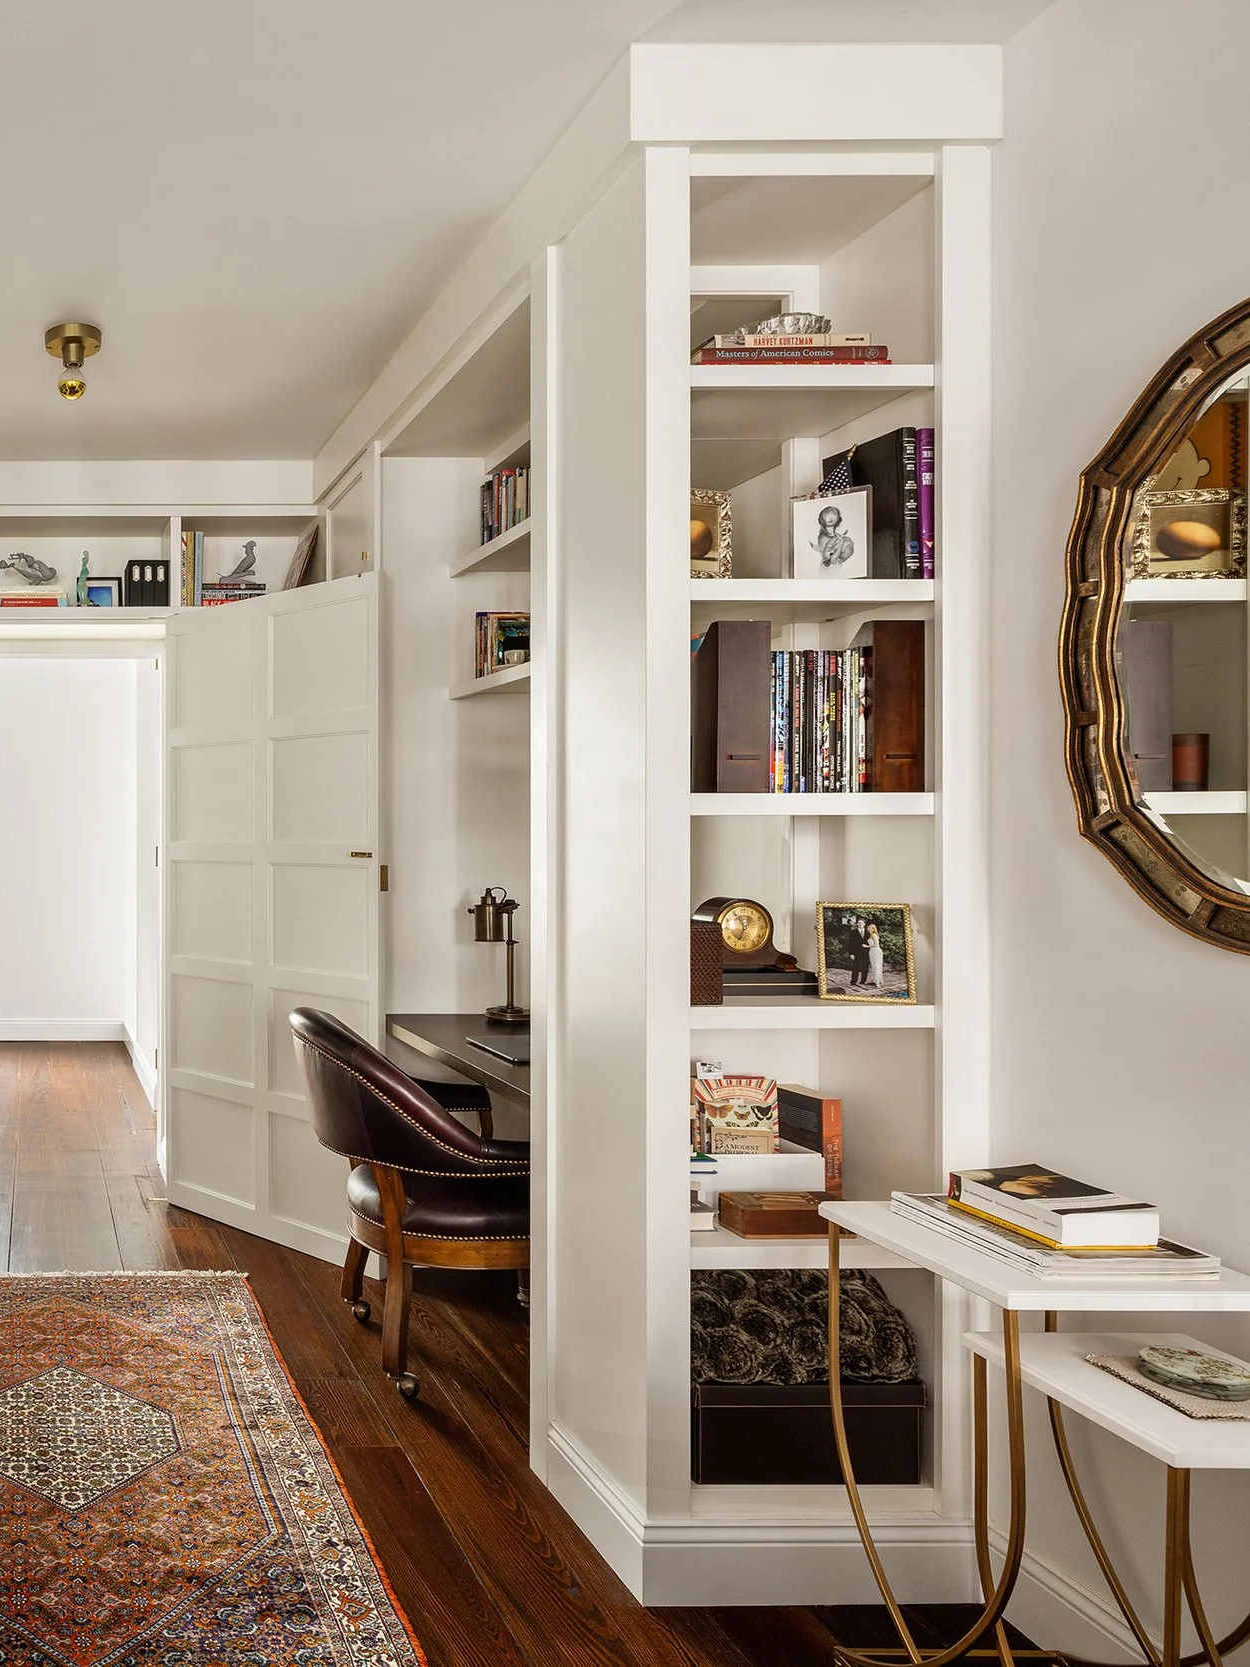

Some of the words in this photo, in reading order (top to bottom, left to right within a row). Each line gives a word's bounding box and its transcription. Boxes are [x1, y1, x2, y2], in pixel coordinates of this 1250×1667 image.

[754, 338, 776, 346] HARVEY
[715, 349, 750, 358] Masters
[751, 349, 759, 360] of
[760, 349, 801, 358] American
[803, 349, 834, 357] Comics
